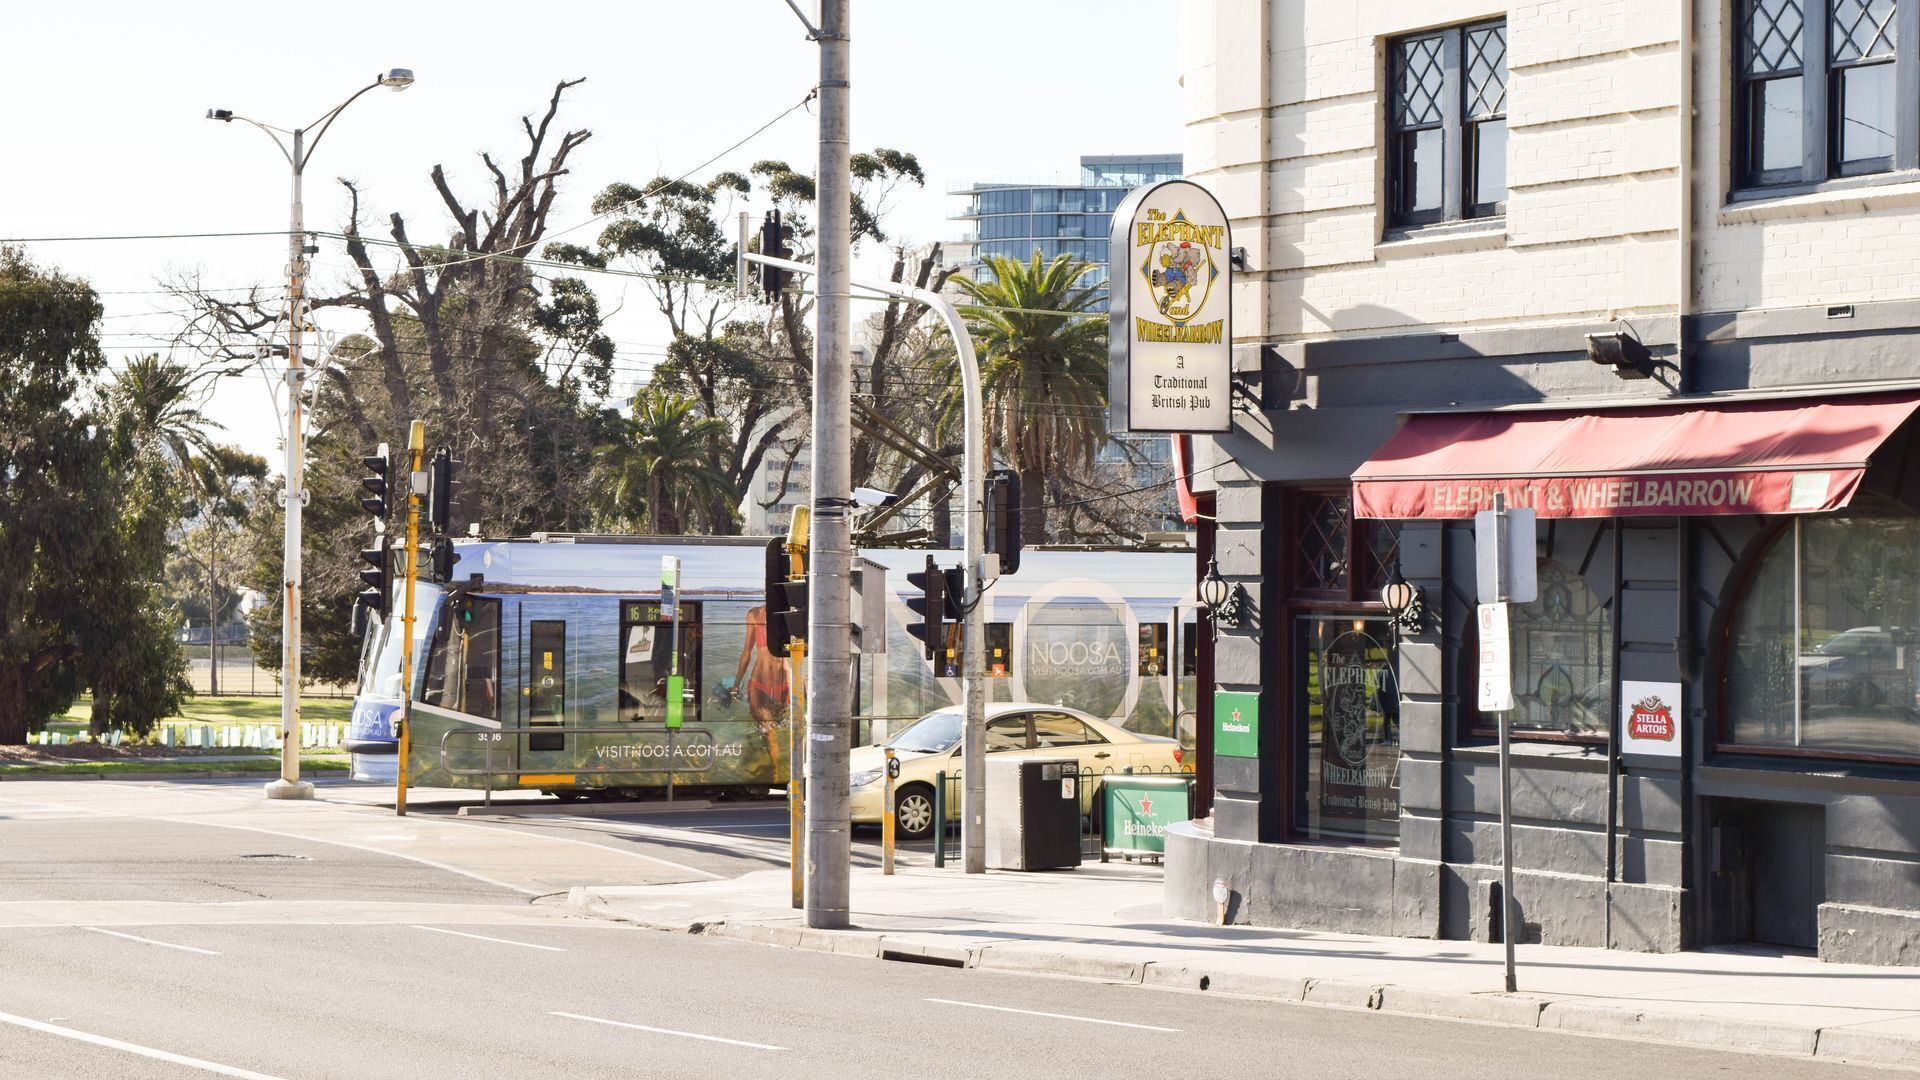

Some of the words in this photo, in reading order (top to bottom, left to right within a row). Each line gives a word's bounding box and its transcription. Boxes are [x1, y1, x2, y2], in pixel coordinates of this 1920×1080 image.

[1147, 208, 1167, 221] The
[1136, 222, 1224, 251] ELEPHANT
[1168, 303, 1190, 316] and
[1136, 316, 1224, 345] WHEELBARROW
[1175, 355, 1185, 369] A
[1153, 374, 1208, 390] Traditional
[1151, 394, 1187, 410] British
[1189, 395, 1211, 411] Pub
[1433, 484, 1541, 511] ELEPHANT
[1546, 484, 1565, 511] &
[1568, 478, 1754, 509] WHEELBARROW
[630, 606, 640, 621] 16
[1031, 641, 1122, 665] NOOSA
[1331, 652, 1346, 664] The
[1031, 666, 1122, 676] VISITNOOSA.COM.AU
[1324, 666, 1389, 693] ELEPHANT
[1636, 713, 1667, 724] STELLA
[1222, 722, 1251, 733] Heineken
[1636, 724, 1668, 735] ARTOIS
[595, 744, 742, 758] VISITNOOSA.COM.AU
[1323, 760, 1389, 789] WHEELBARROW
